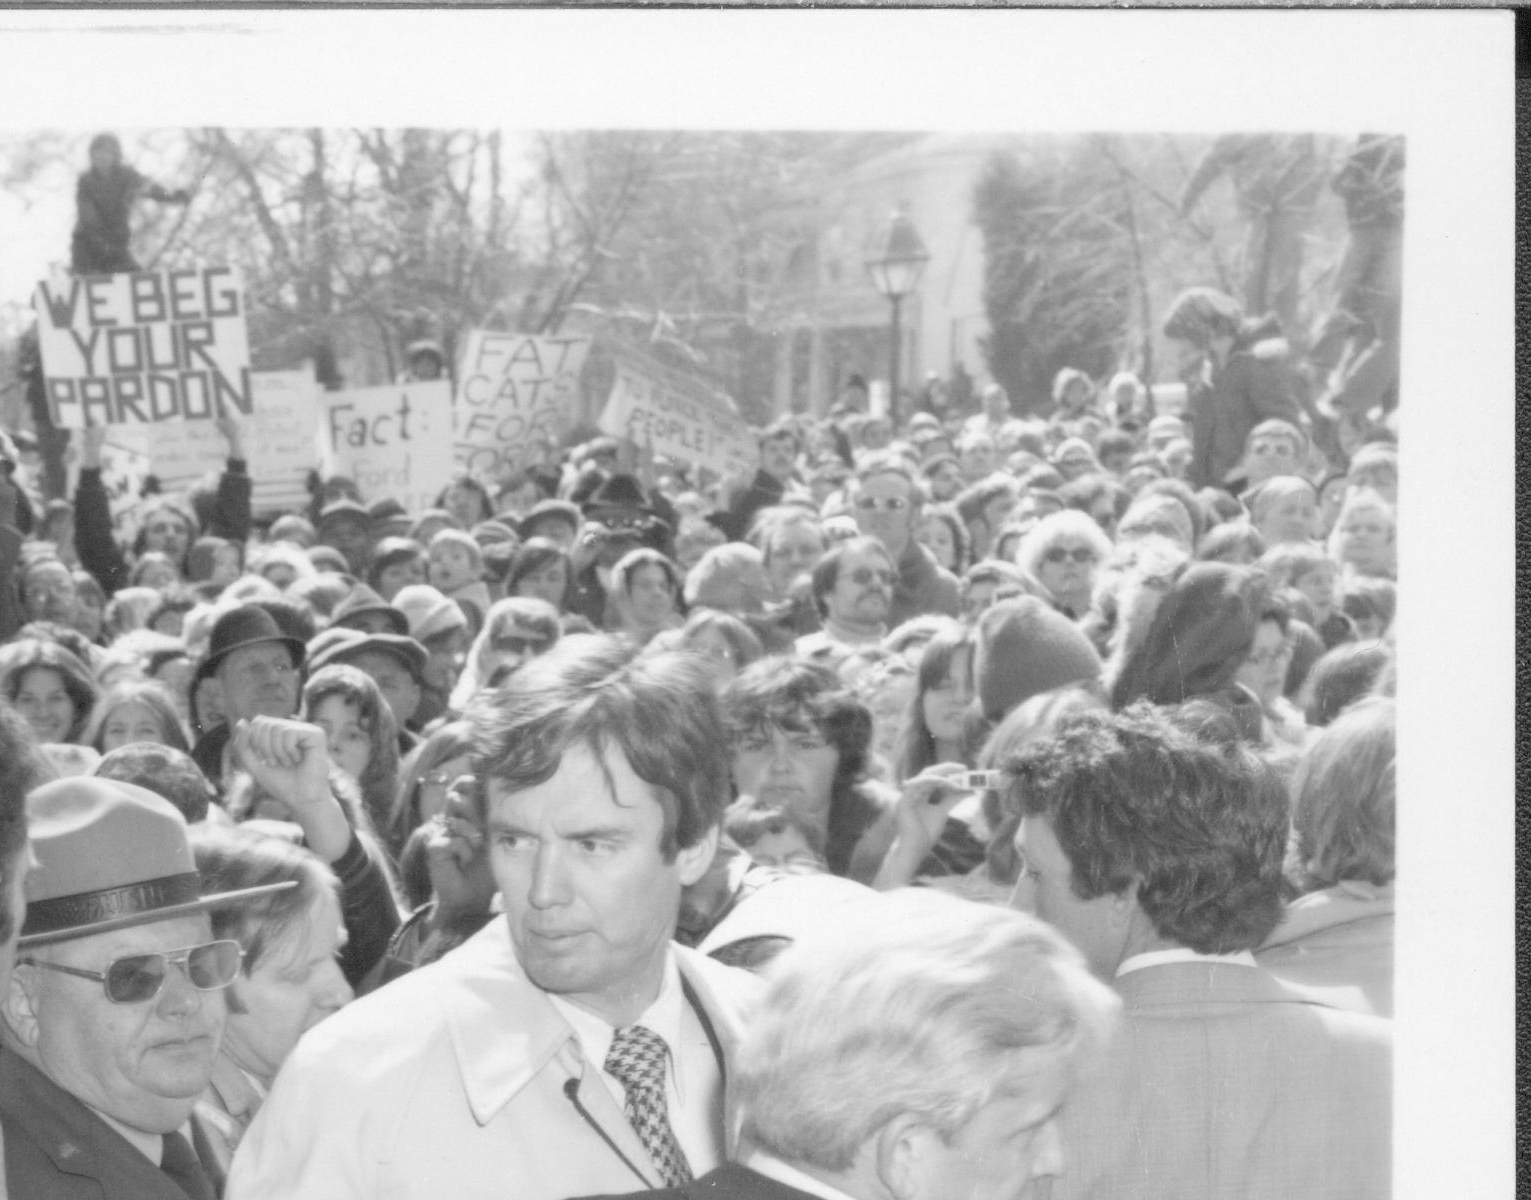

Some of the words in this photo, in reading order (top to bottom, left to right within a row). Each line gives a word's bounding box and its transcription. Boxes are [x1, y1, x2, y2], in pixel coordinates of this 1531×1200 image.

[37, 274, 118, 328] WE
[130, 267, 239, 323] BEG
[71, 320, 218, 377] YOUR
[475, 335, 587, 376] FAT
[47, 366, 253, 428] PARDON
[328, 391, 430, 452] Fact:
